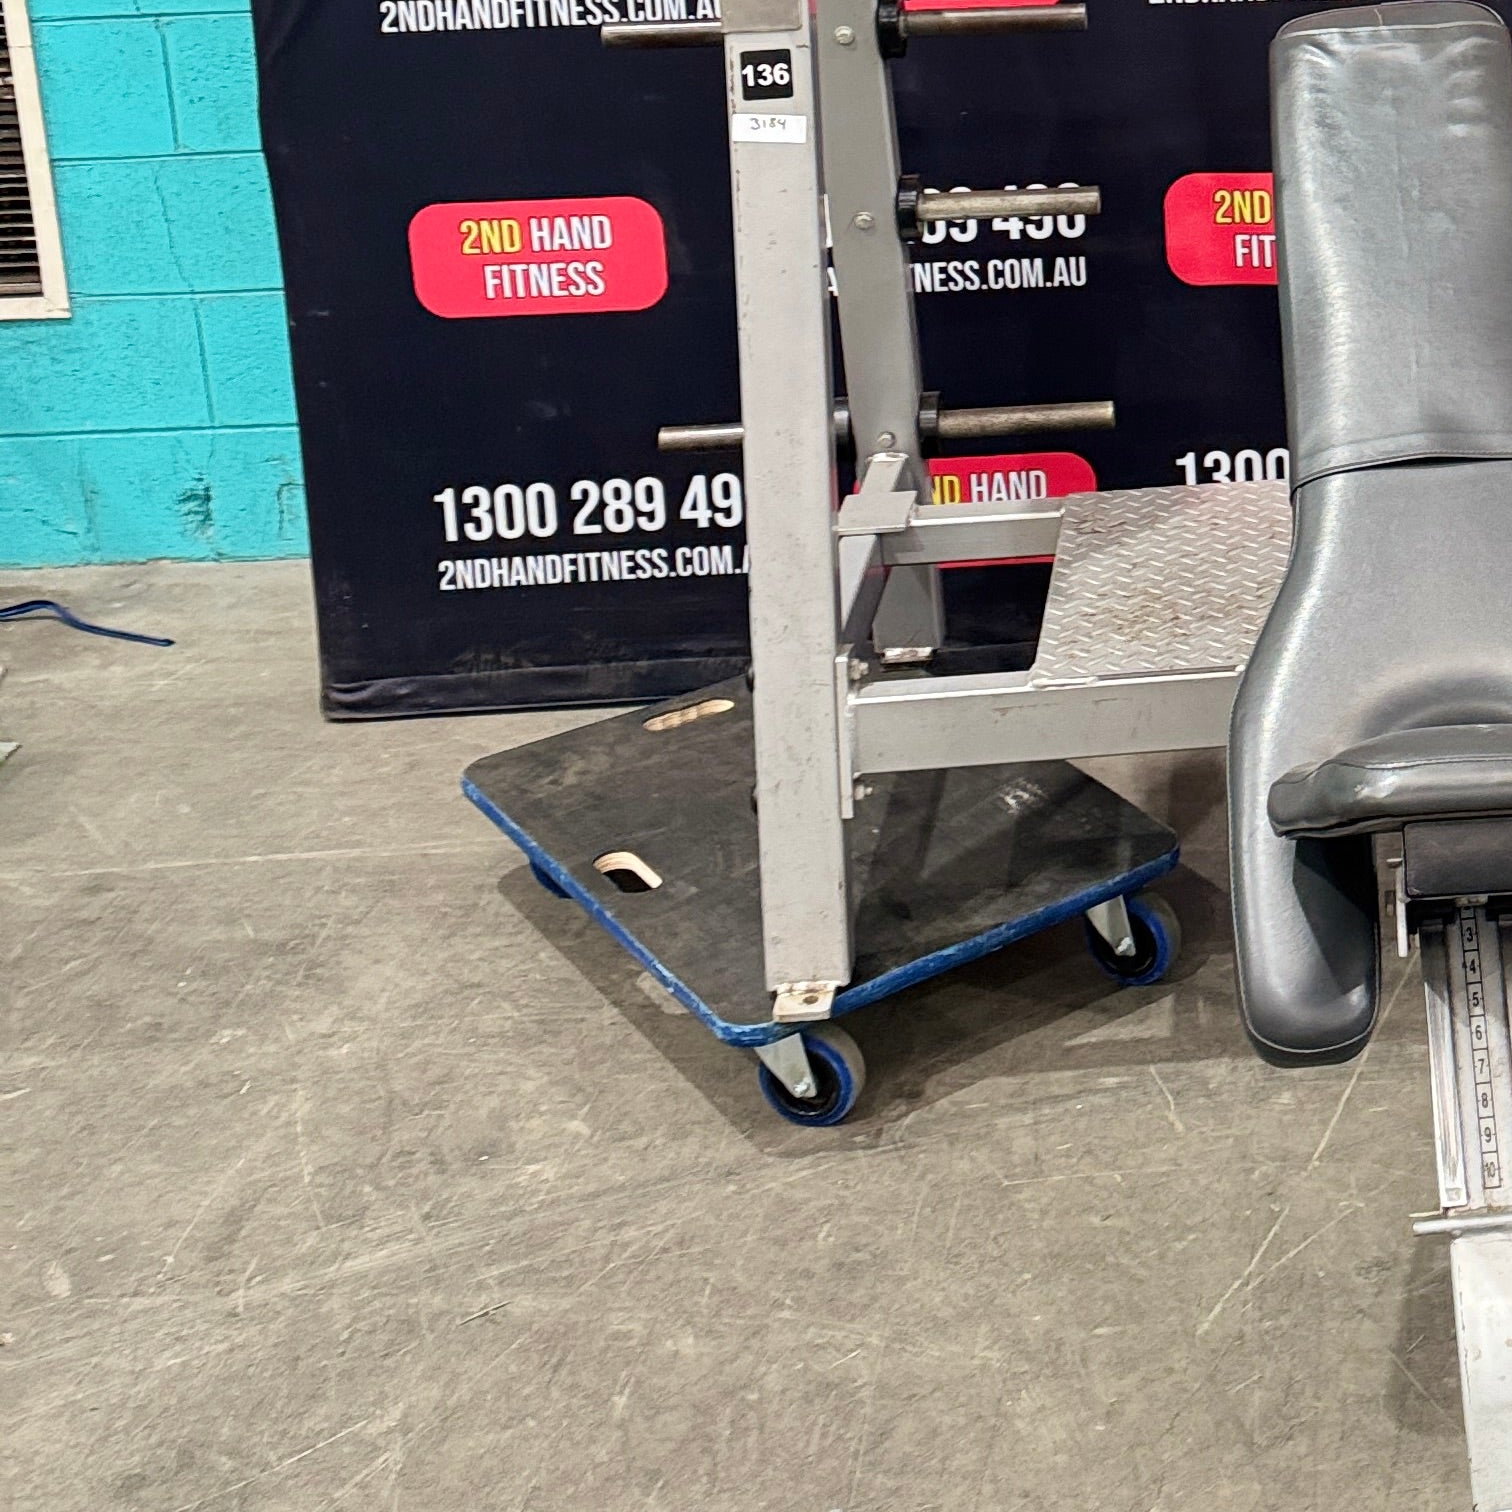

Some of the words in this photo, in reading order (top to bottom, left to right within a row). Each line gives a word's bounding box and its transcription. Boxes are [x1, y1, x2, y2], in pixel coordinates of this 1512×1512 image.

[742, 63, 790, 86] 136
[749, 118, 787, 130] 3184
[1214, 190, 1272, 223] 2ND
[460, 219, 522, 254] 2ND
[529, 215, 612, 252] HAND
[484, 261, 605, 299] FITNESS
[970, 470, 1046, 502] HAND
[433, 482, 558, 542] 1300
[570, 476, 666, 535] 289
[680, 472, 743, 528] 49
[1465, 927, 1473, 942] 3
[1469, 959, 1477, 974] 4
[1472, 992, 1479, 1007] 5
[1475, 1025, 1483, 1040] 6
[1478, 1059, 1485, 1074] 7
[1481, 1093, 1489, 1108] 8
[1484, 1127, 1491, 1143] 9
[1485, 1161, 1496, 1178] 10
